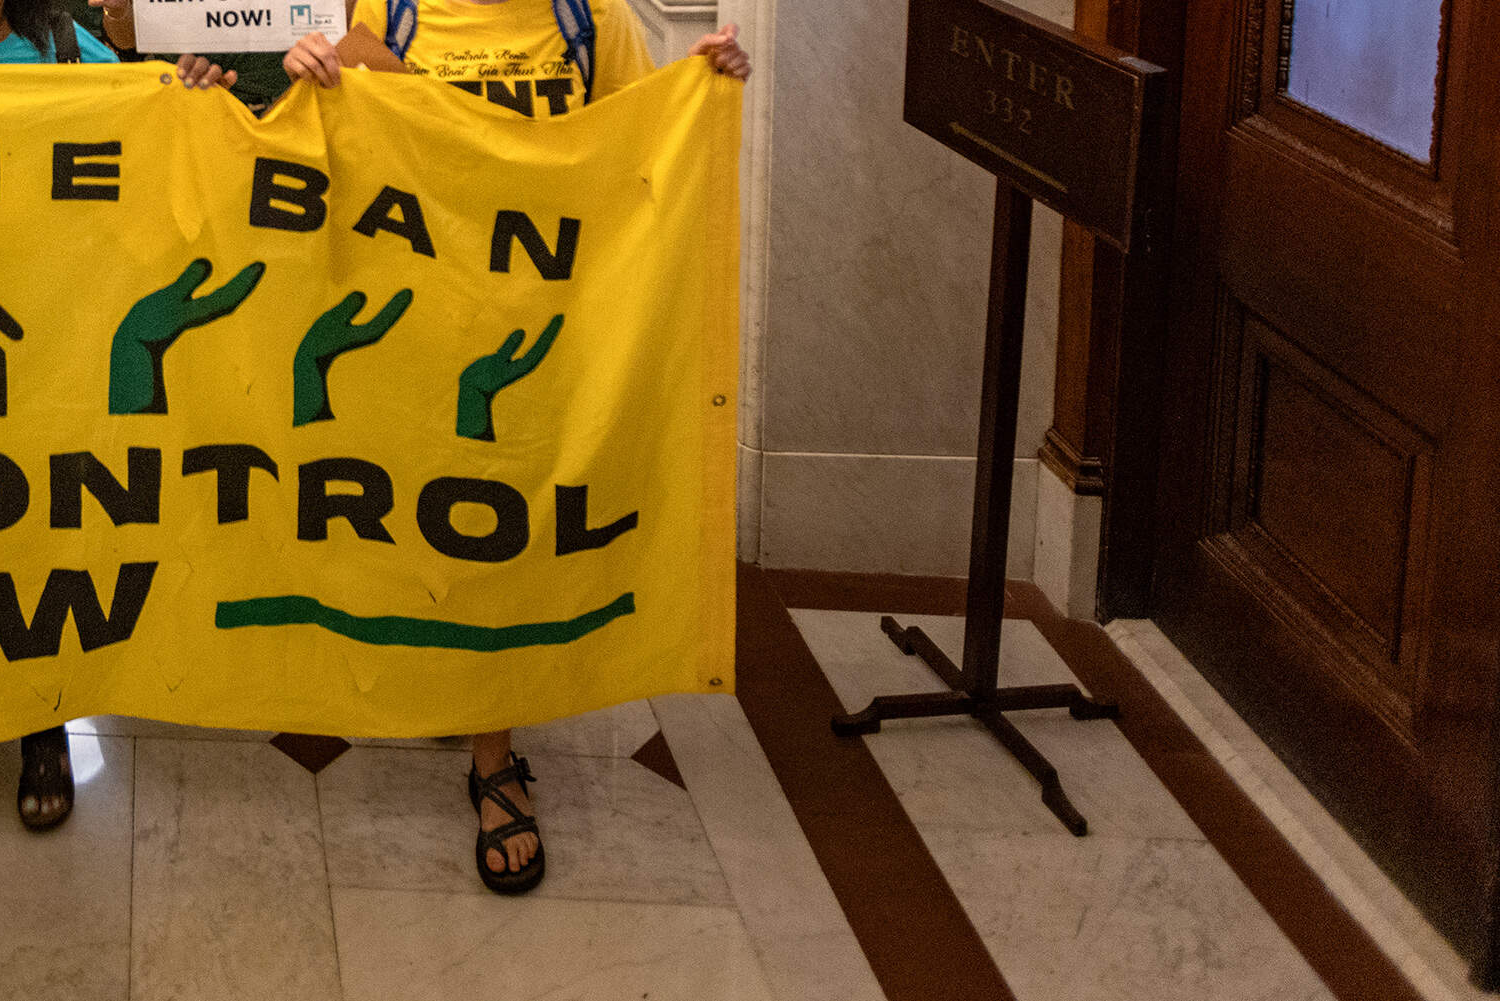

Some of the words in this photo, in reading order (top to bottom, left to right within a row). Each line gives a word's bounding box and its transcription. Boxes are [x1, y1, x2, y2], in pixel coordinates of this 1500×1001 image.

[206, 10, 271, 28] NOW!
[952, 24, 1076, 111] ENTER
[985, 90, 1032, 135] 332
[249, 156, 581, 281] BAN
